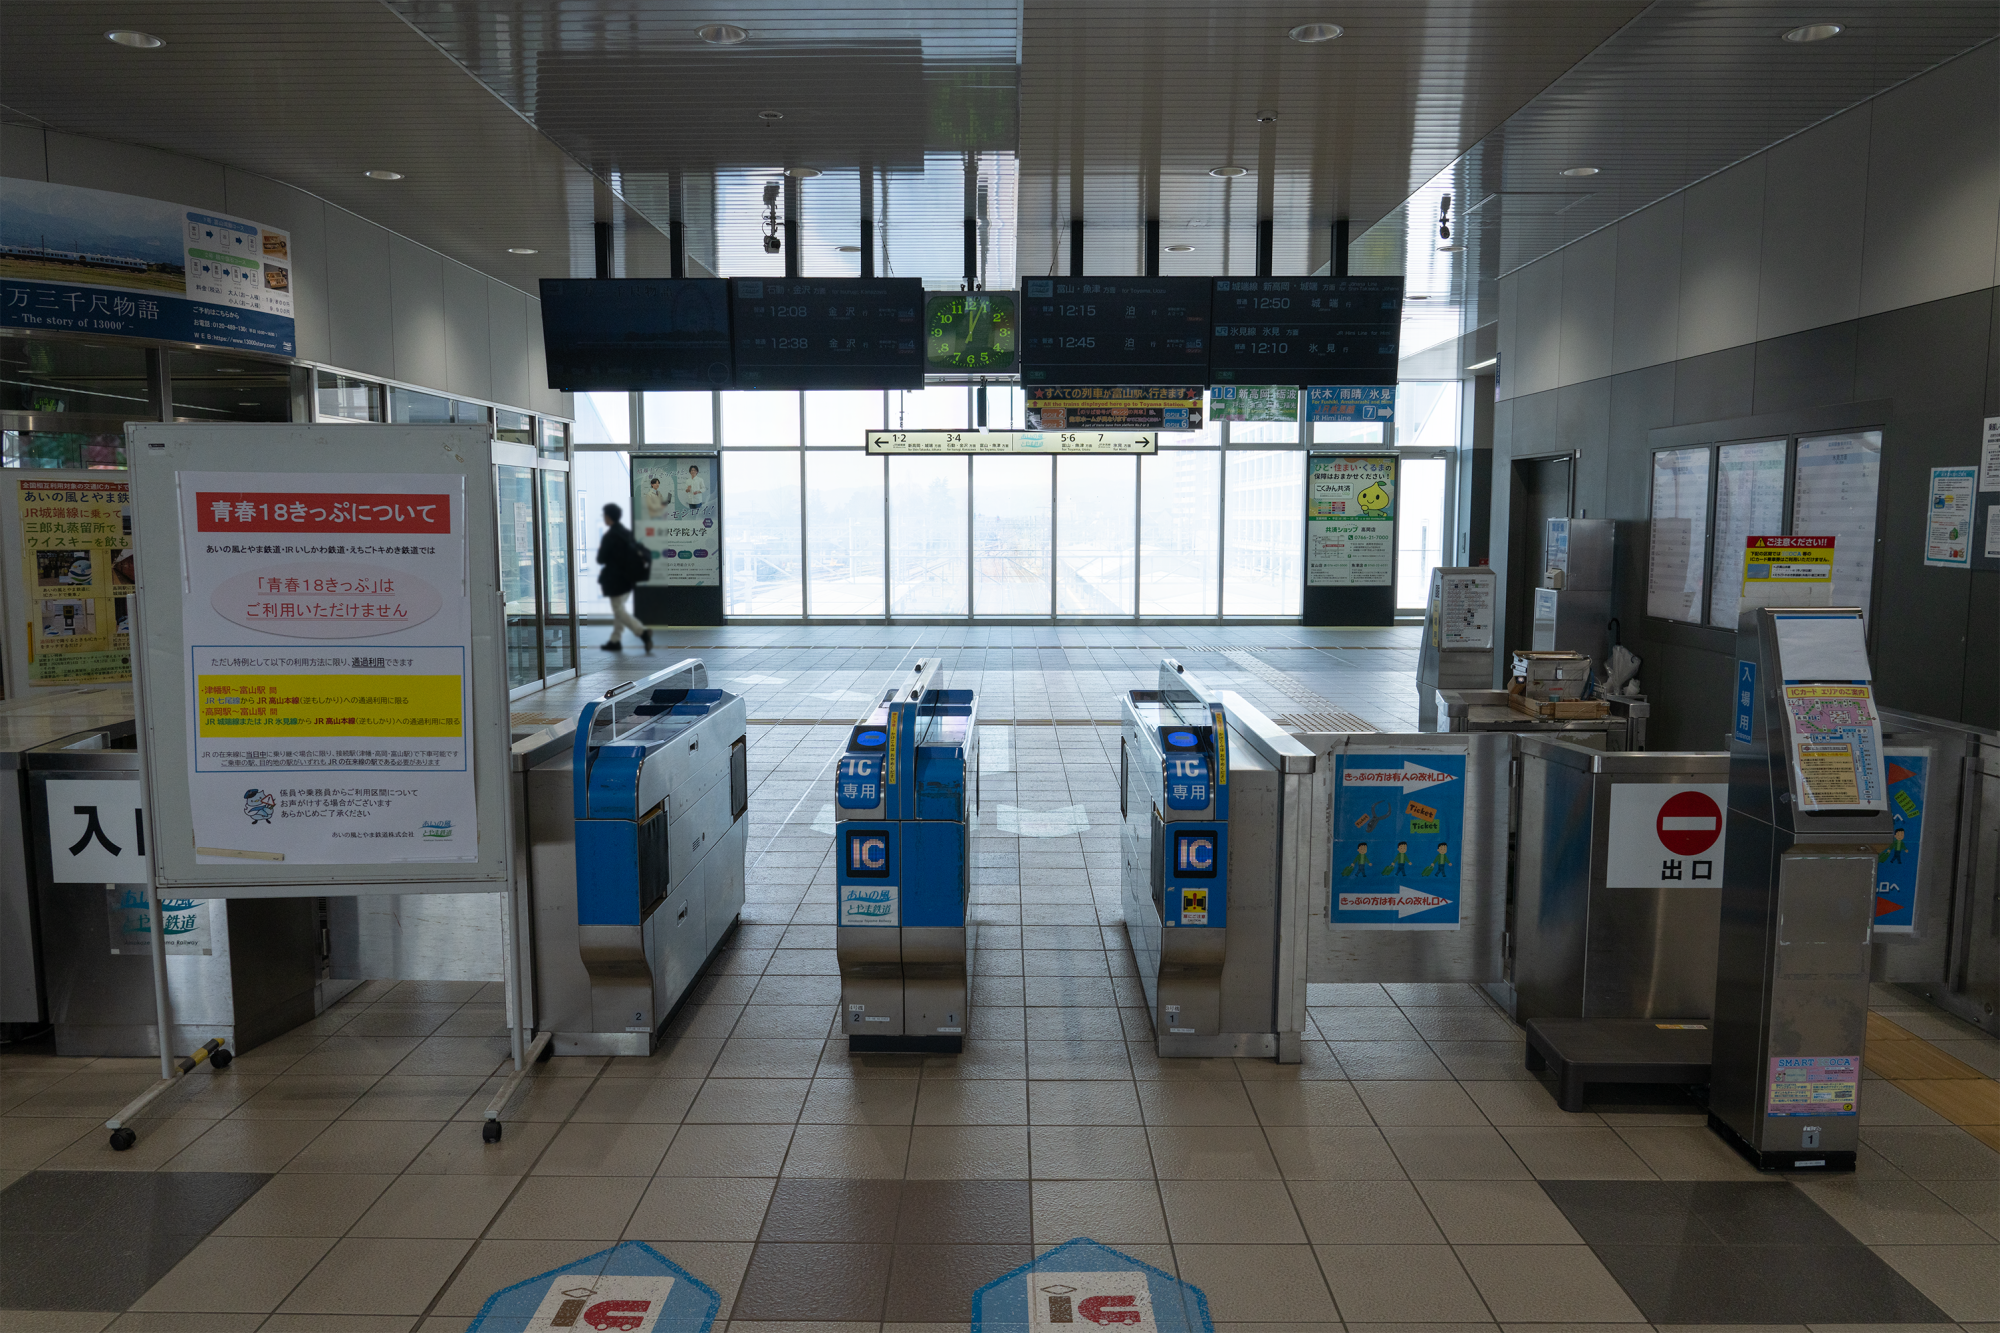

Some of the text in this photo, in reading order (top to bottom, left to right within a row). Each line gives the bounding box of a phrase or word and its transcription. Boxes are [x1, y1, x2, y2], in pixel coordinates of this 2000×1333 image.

[0, 287, 160, 320] 万三千尺物語
[965, 302, 977, 310] 12
[983, 304, 987, 313] 1
[1253, 298, 1290, 309] 12:50
[770, 306, 807, 317] 12:08
[952, 305, 962, 314] 11
[1059, 305, 1135, 316] 12:15 泊
[22, 313, 42, 324] The
[46, 316, 74, 327] story
[78, 318, 88, 328] of
[941, 315, 952, 323] 10
[993, 314, 1001, 322] 2
[934, 328, 942, 337] 9
[999, 328, 1007, 337] 3
[1230, 327, 1256, 336] 氷見線
[1262, 327, 1280, 336] 氷見
[771, 338, 808, 349] 12:38
[941, 343, 949, 352] 8
[993, 343, 1001, 351] 4
[1059, 337, 1134, 348] 12:45 泊
[1251, 343, 1288, 354] 12:10
[953, 352, 961, 361] 7
[967, 355, 975, 364] 6
[980, 352, 988, 361] 5
[1045, 388, 1186, 398] すべての列車が富山駅へ行きます
[1227, 388, 1233, 398] 2
[1311, 388, 1390, 399] 伏木/雨晴/氷見
[1366, 408, 1373, 418] 7
[1098, 434, 1104, 442] 7
[1315, 464, 1391, 472] ひと・住まい・くるまの
[24, 507, 121, 519] JR城端線に乗って
[210, 500, 437, 523] 青春18きっぷについて
[26, 522, 116, 534] 三郎丸蒸留所で
[28, 536, 129, 548] ウイスキーを飲も
[258, 577, 395, 592] 「青春18きっぷ」は
[246, 602, 408, 618] ご利用いただけません
[211, 657, 414, 668] ただし特例として以下の利用方法に限り、通過利用できます
[848, 759, 872, 776] IC
[1176, 760, 1199, 777] IC
[1344, 772, 1454, 782] きっぷの方は有人の改札口へ
[280, 788, 418, 797] 係員や乗務員からご利用区間について
[843, 784, 876, 799] 専用
[1172, 785, 1205, 800] 専用
[280, 799, 392, 807] お声がけする場合がございます
[280, 809, 371, 818] あらかじめご了承ください
[1409, 804, 1434, 818] Ticket
[68, 806, 145, 856] 入
[853, 838, 885, 868] IC
[1181, 839, 1212, 869] IC
[1661, 859, 1712, 880] 出口
[1341, 897, 1448, 906] きっぷの方は有人の改札口へ
[636, 1013, 641, 1021] 2
[854, 1014, 860, 1022] 2
[1778, 1058, 1814, 1067] SMART
